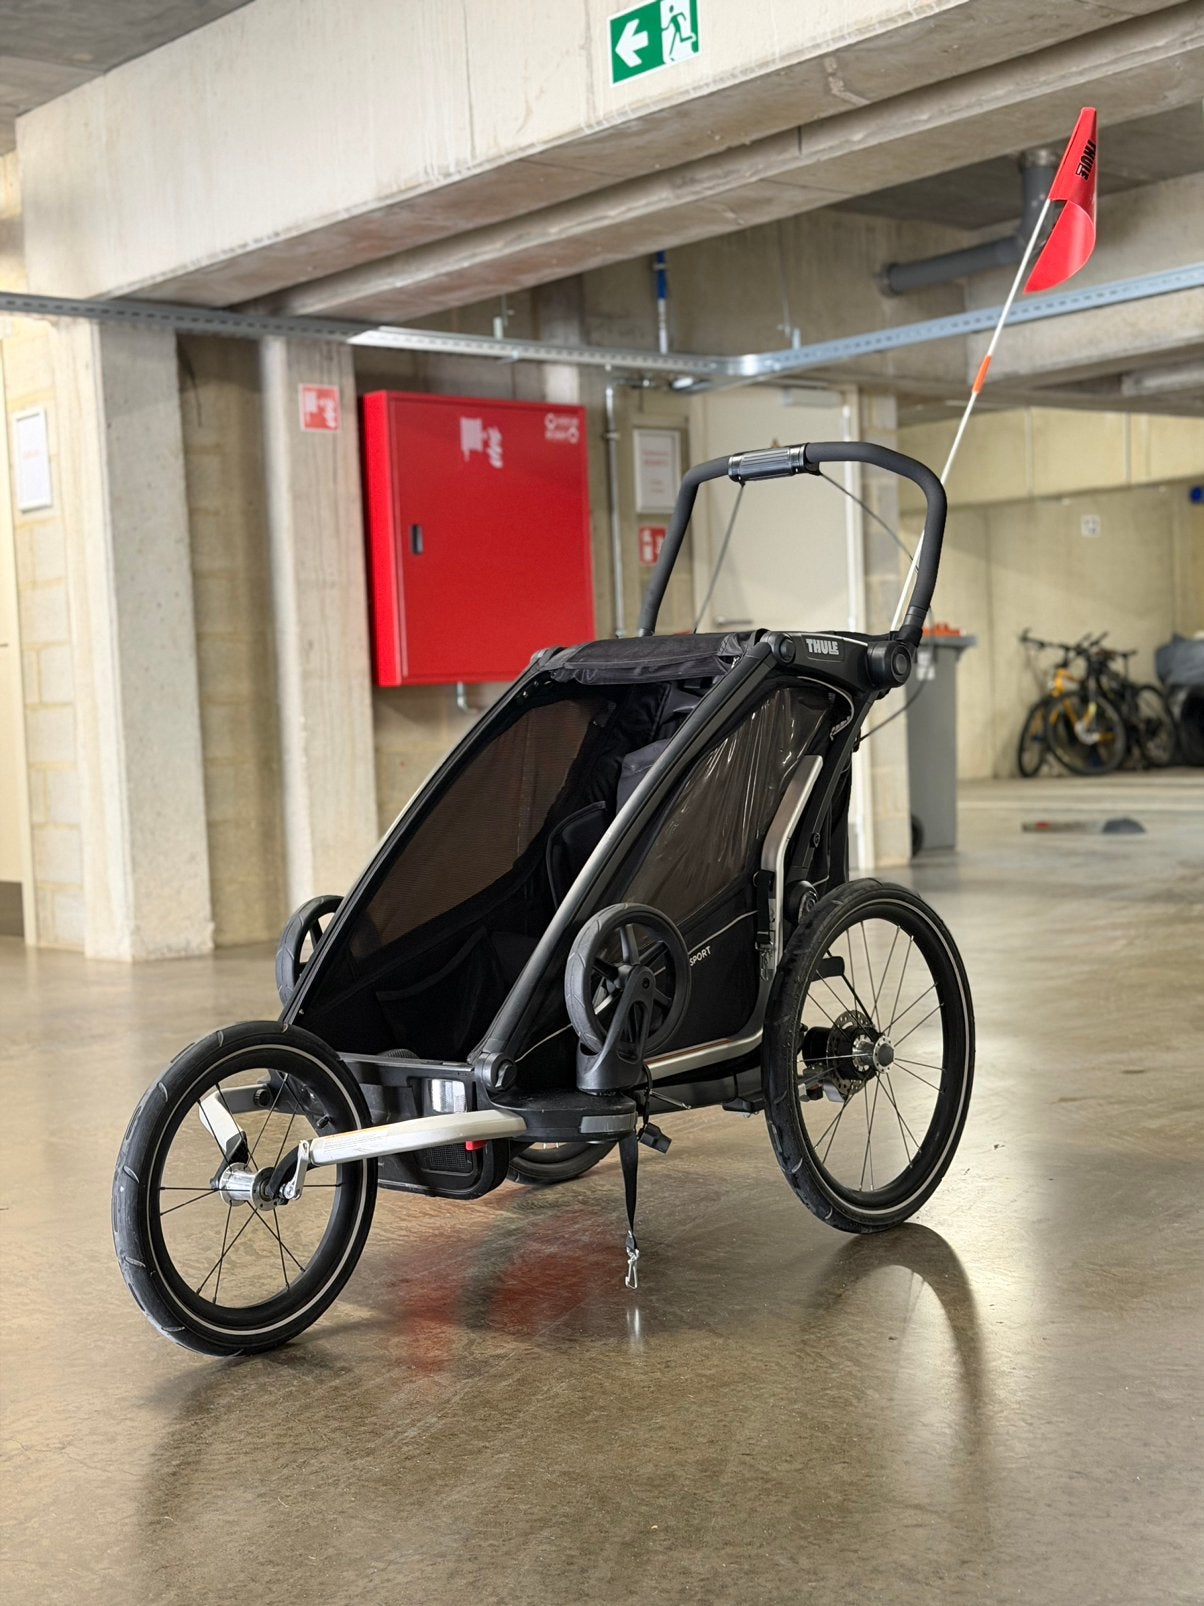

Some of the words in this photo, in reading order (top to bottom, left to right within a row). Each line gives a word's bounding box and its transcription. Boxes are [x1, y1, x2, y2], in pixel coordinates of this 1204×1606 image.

[1075, 139, 1097, 180] THULE
[806, 638, 840, 655] THULE
[689, 945, 712, 967] SPORT
